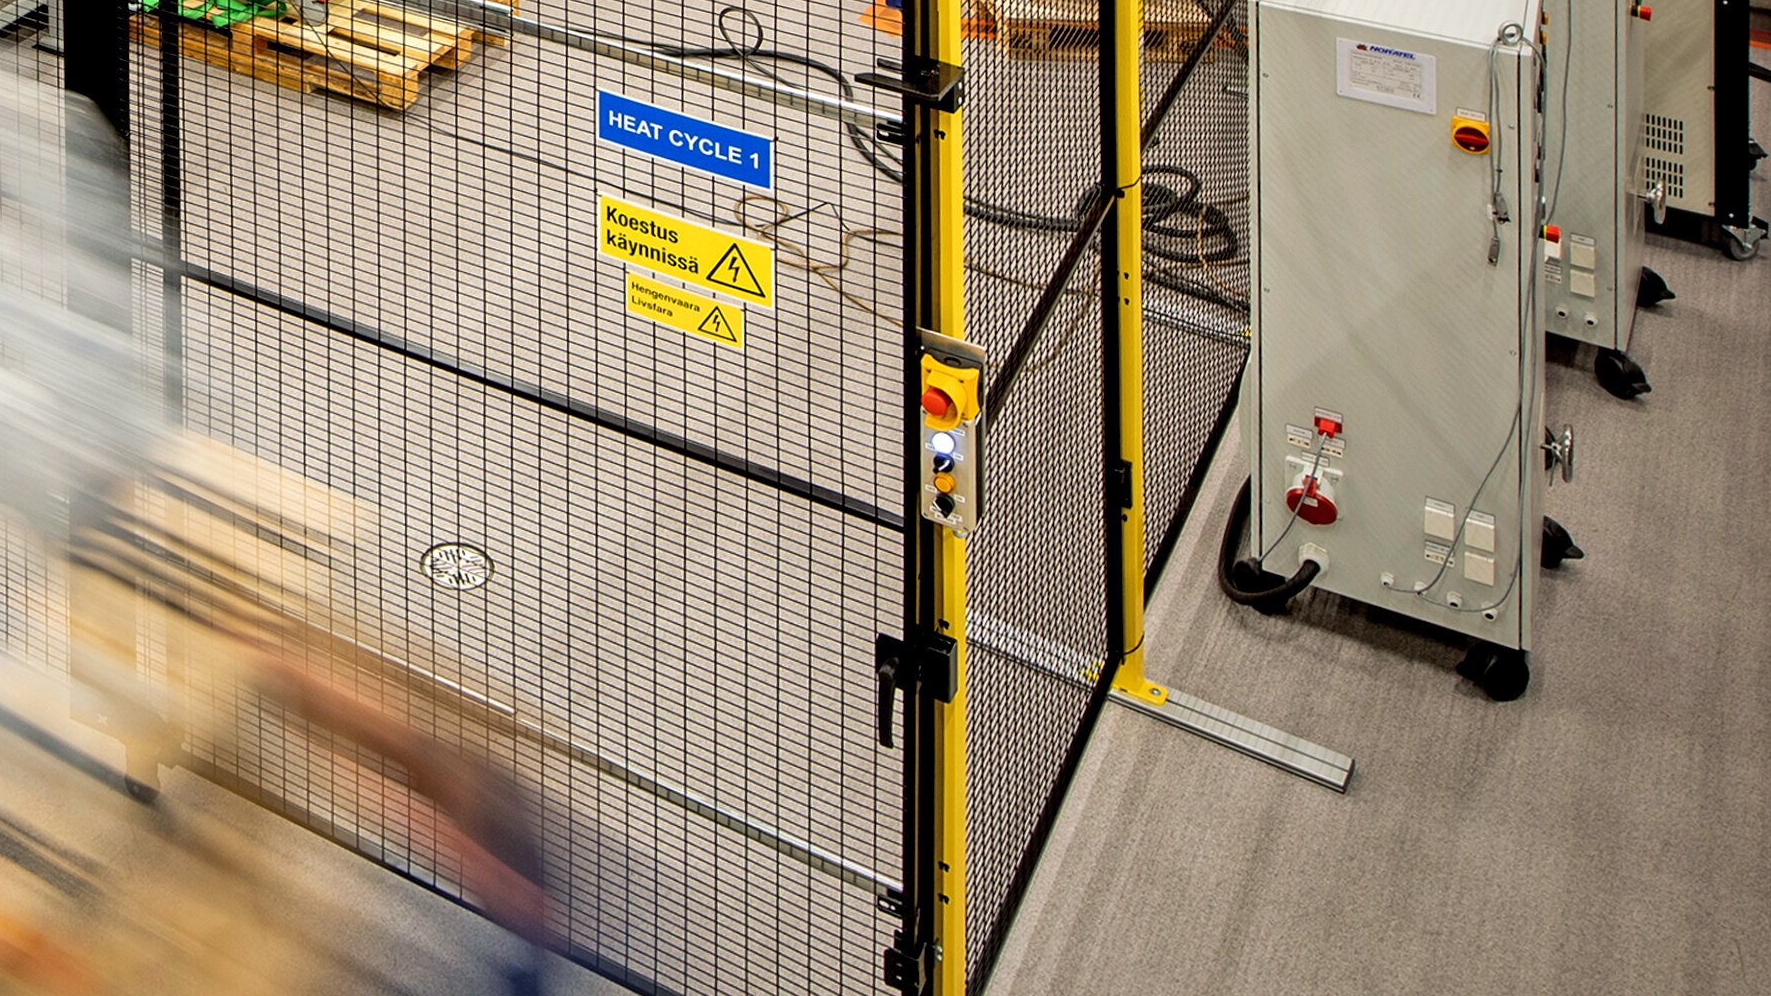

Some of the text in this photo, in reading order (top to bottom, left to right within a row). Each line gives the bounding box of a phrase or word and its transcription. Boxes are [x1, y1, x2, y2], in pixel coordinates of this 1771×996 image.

[608, 110, 760, 170] HEAT CYCLE 1
[606, 206, 679, 244] Koestus
[606, 229, 700, 274] käynnissä
[631, 281, 701, 313] Hengenvaara
